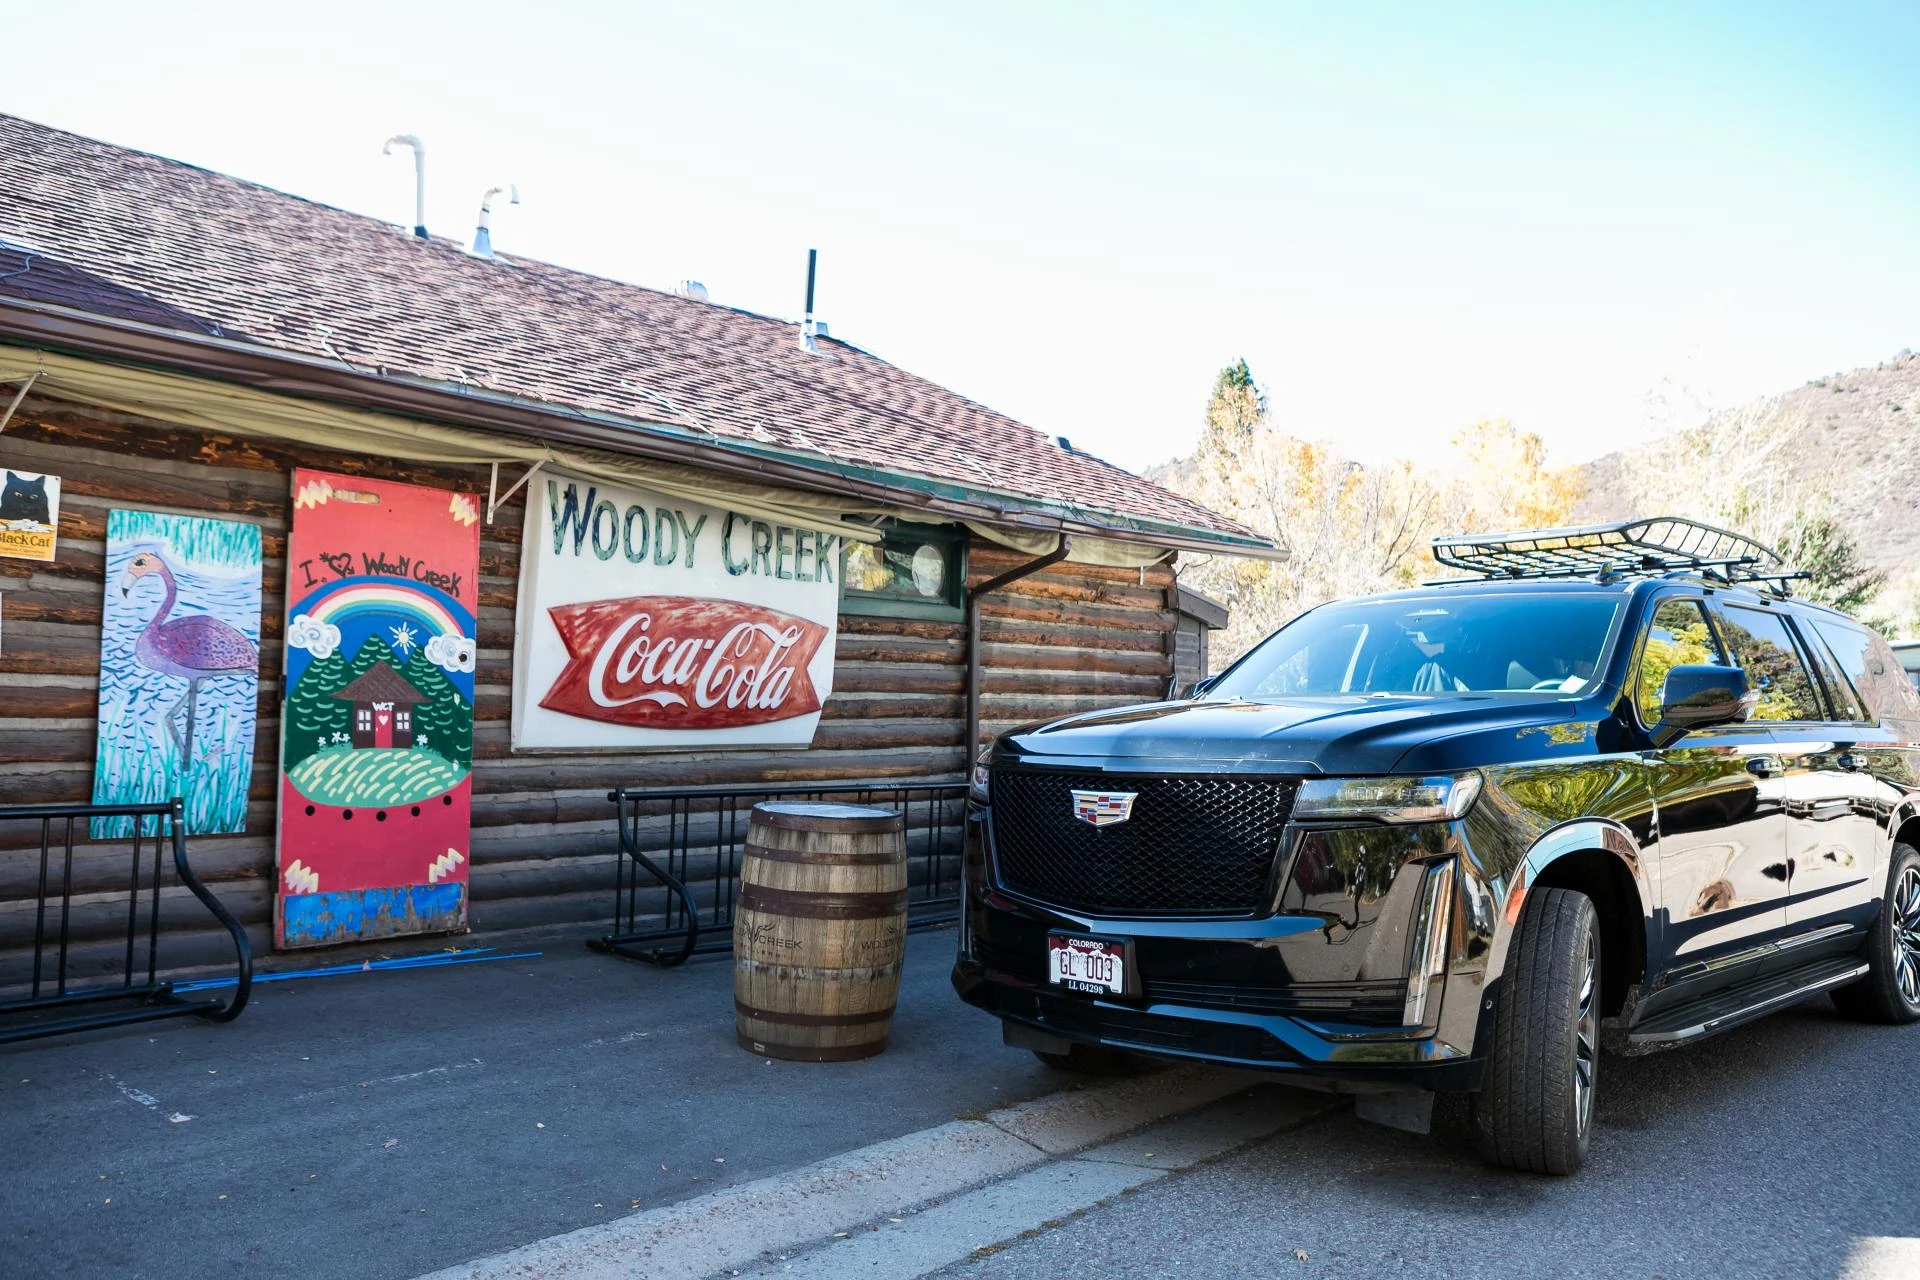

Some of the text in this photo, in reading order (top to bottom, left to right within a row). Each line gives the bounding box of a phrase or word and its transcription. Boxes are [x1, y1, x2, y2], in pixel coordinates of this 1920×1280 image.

[546, 479, 840, 584] WOODY CREEK
[30, 535, 50, 547] Cat
[299, 559, 318, 588] I
[587, 612, 805, 710] Coca-Cola
[372, 702, 395, 712] WCT
[758, 935, 803, 949] CREEK
[1068, 938, 1104, 950] COLORADO
[1060, 951, 1113, 982] GL 003
[1068, 980, 1104, 995] LL 04298
